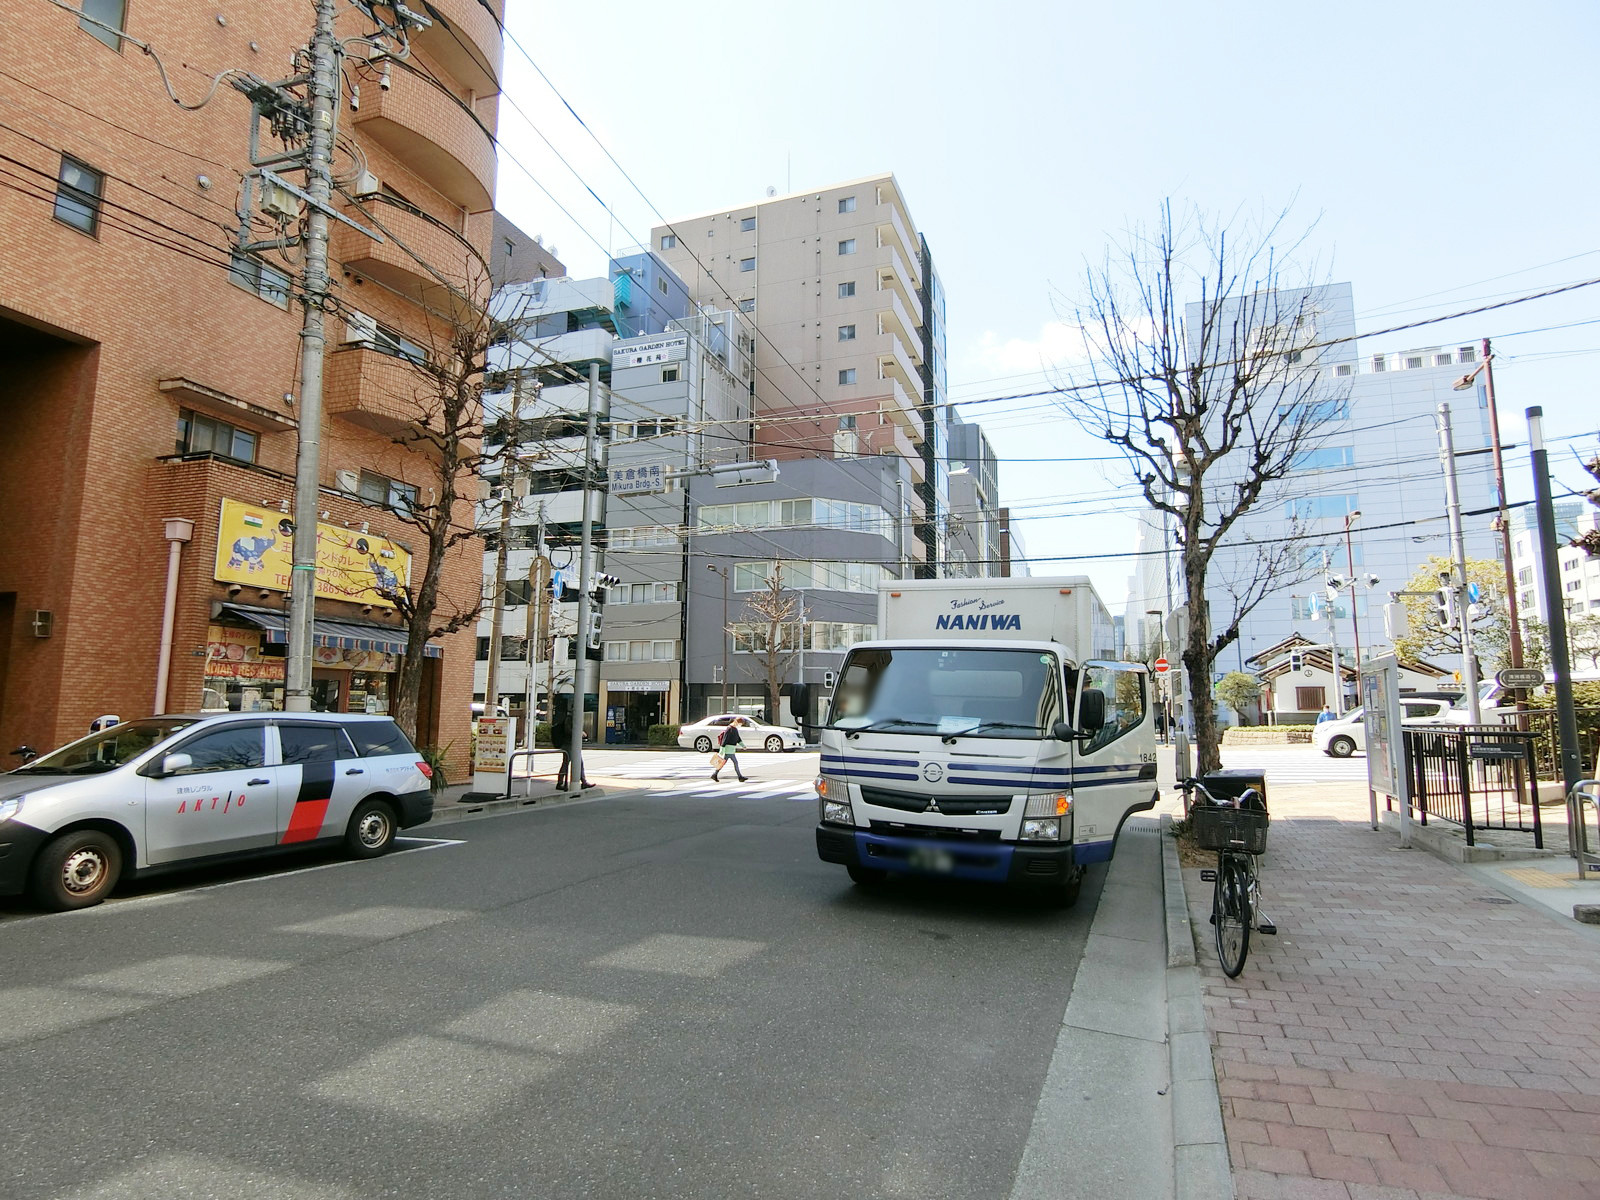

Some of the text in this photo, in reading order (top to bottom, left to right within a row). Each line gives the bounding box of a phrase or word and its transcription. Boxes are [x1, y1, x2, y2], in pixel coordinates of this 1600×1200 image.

[614, 339, 686, 356] SAKURA GARDEN HOTEL
[613, 465, 660, 481] 美倉橋南
[611, 482, 633, 491] Mikura
[950, 597, 1005, 610] Fashion Service
[935, 614, 1022, 631] NANIWA
[1139, 753, 1157, 763] 1842
[177, 790, 246, 814] AKTIO
